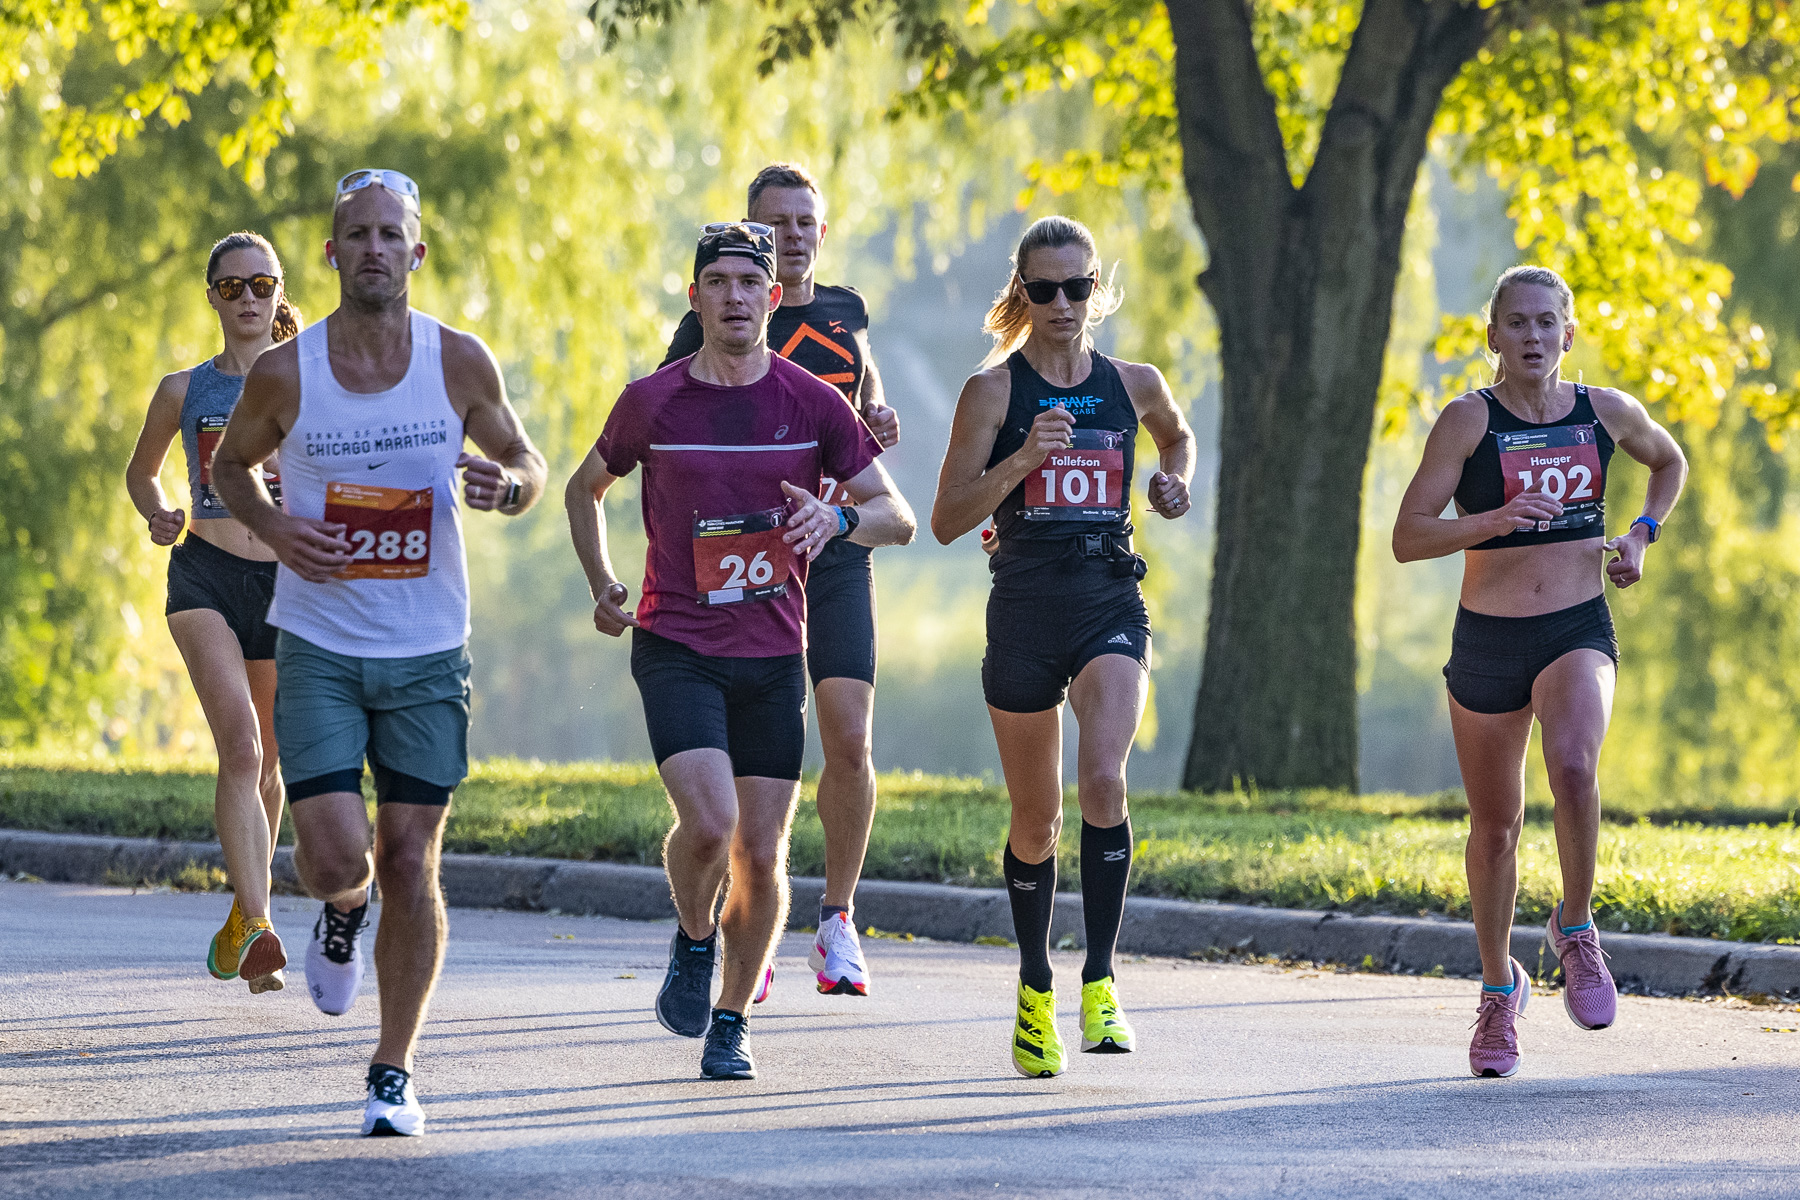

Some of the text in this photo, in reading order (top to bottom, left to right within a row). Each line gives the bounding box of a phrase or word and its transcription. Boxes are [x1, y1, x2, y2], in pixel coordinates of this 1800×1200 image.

[1048, 395, 1096, 409] BRAVE
[1072, 407, 1096, 415] GABE
[305, 418, 447, 441] BANK OF AMERICA
[306, 430, 448, 457] CHICAGO MARATHON
[1050, 455, 1101, 467] Tollefson
[1530, 455, 1572, 467] Hauger
[1041, 468, 1107, 504] 101
[1517, 464, 1593, 501] 102
[719, 550, 774, 589] 26
